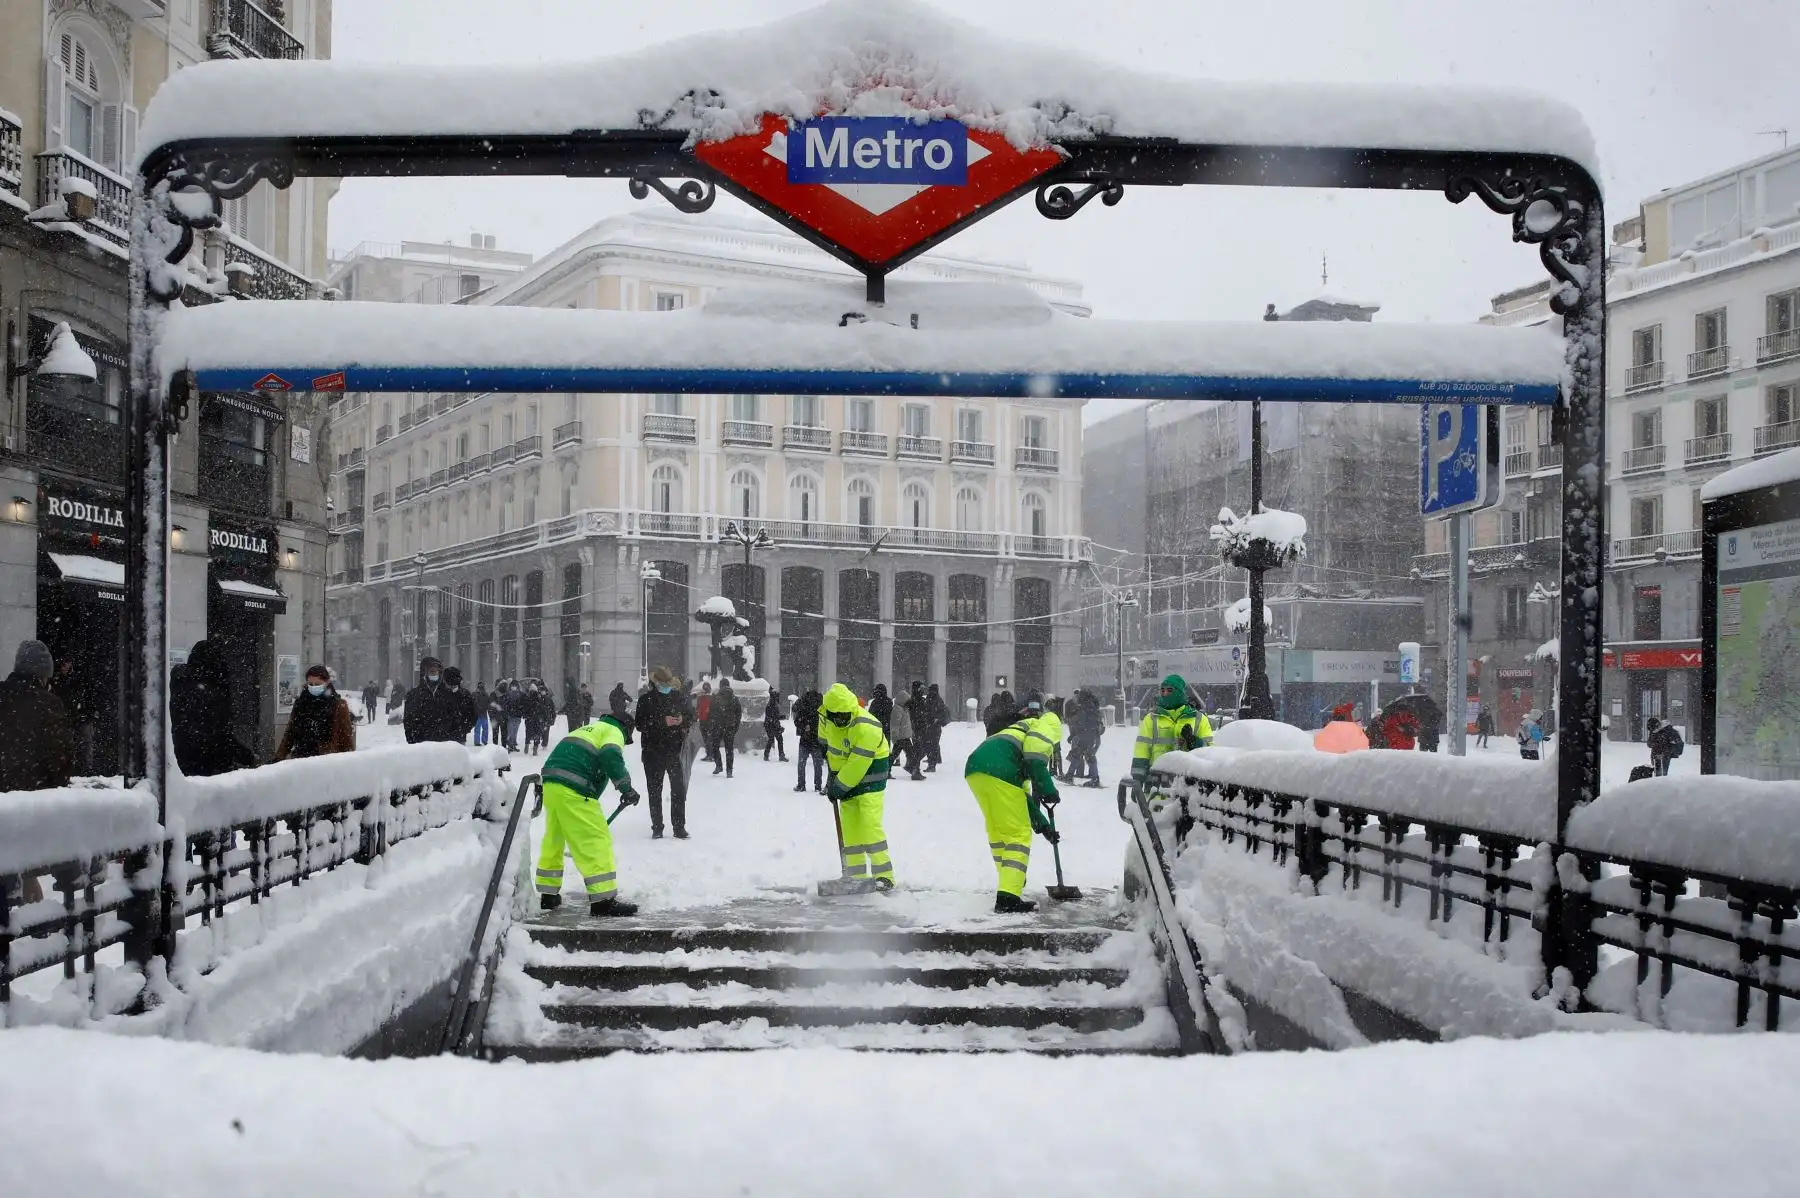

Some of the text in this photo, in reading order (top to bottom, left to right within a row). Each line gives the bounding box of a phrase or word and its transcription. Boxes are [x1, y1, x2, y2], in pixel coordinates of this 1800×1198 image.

[805, 127, 953, 169] Metro
[1427, 403, 1463, 503] P
[47, 496, 125, 528] RODILLA
[210, 529, 268, 553] RODILLA
[97, 591, 125, 602] RODILLA
[244, 600, 266, 609] RODILLA
